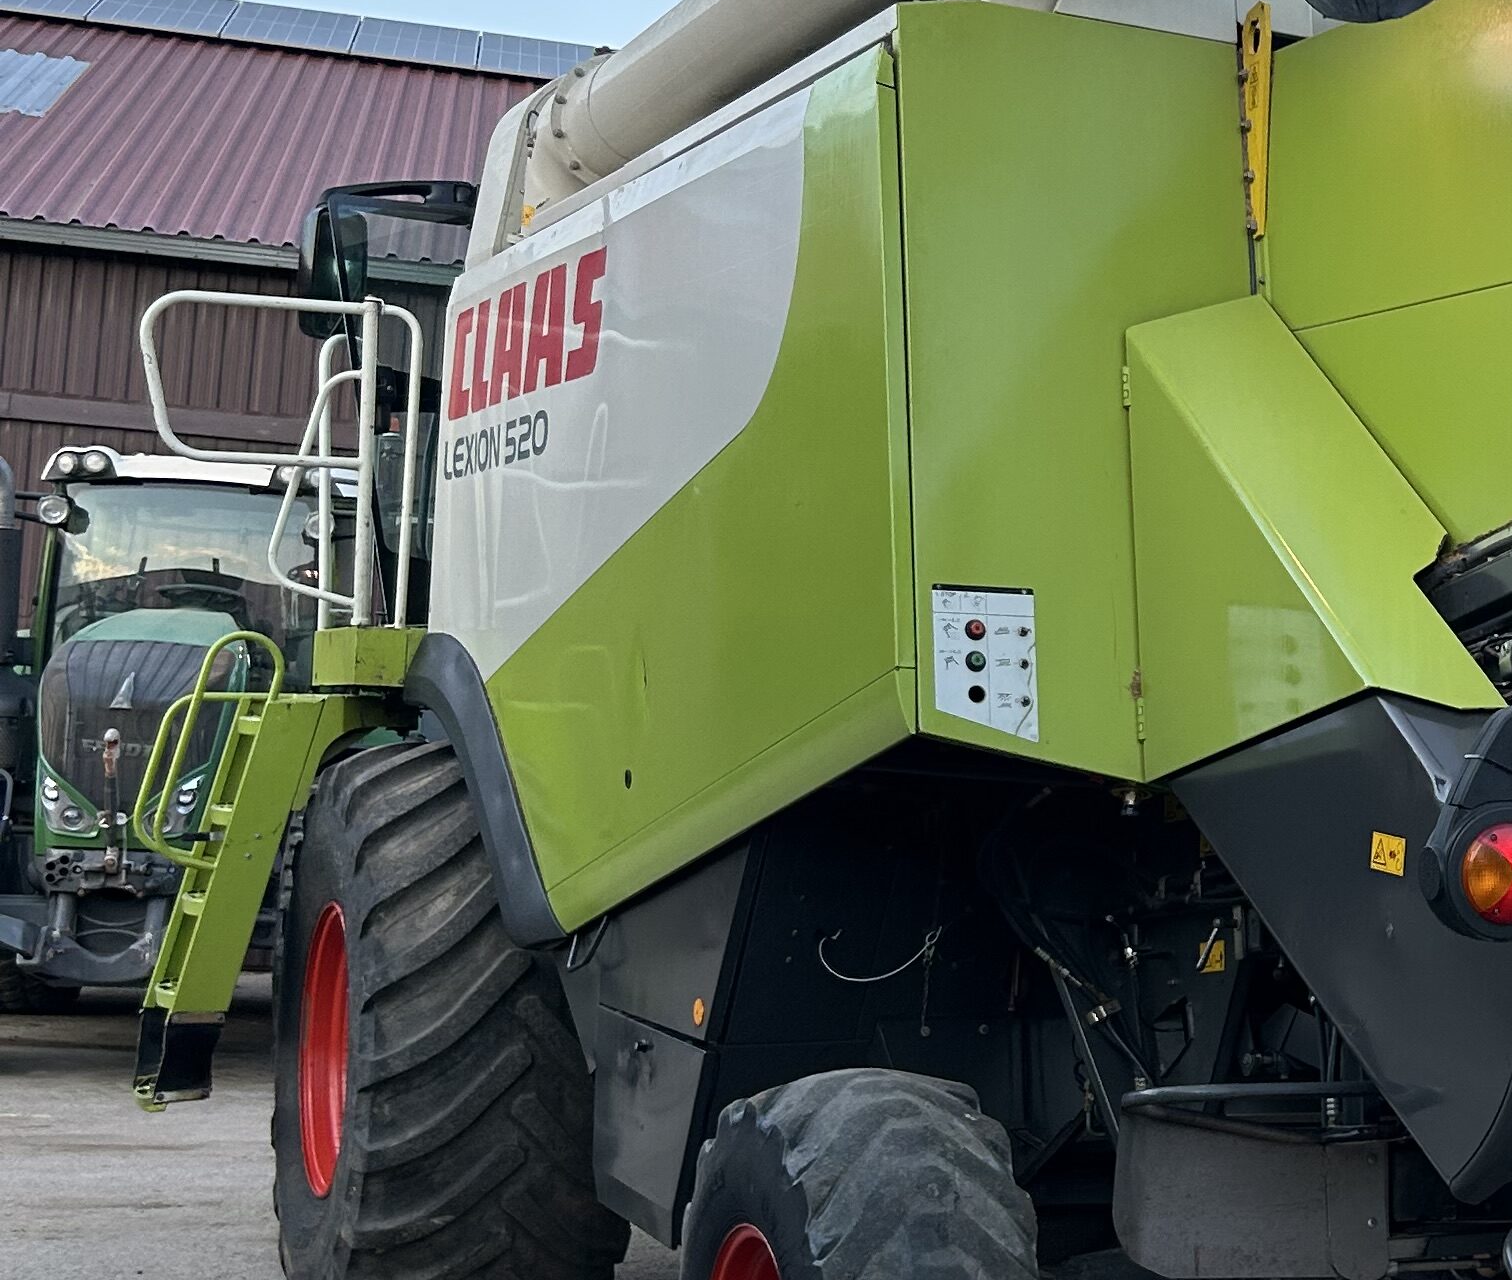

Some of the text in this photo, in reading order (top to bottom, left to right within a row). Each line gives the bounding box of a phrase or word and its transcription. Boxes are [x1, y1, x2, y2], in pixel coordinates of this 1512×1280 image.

[448, 245, 607, 422] CLAAS
[443, 409, 549, 480] LEXION 520
